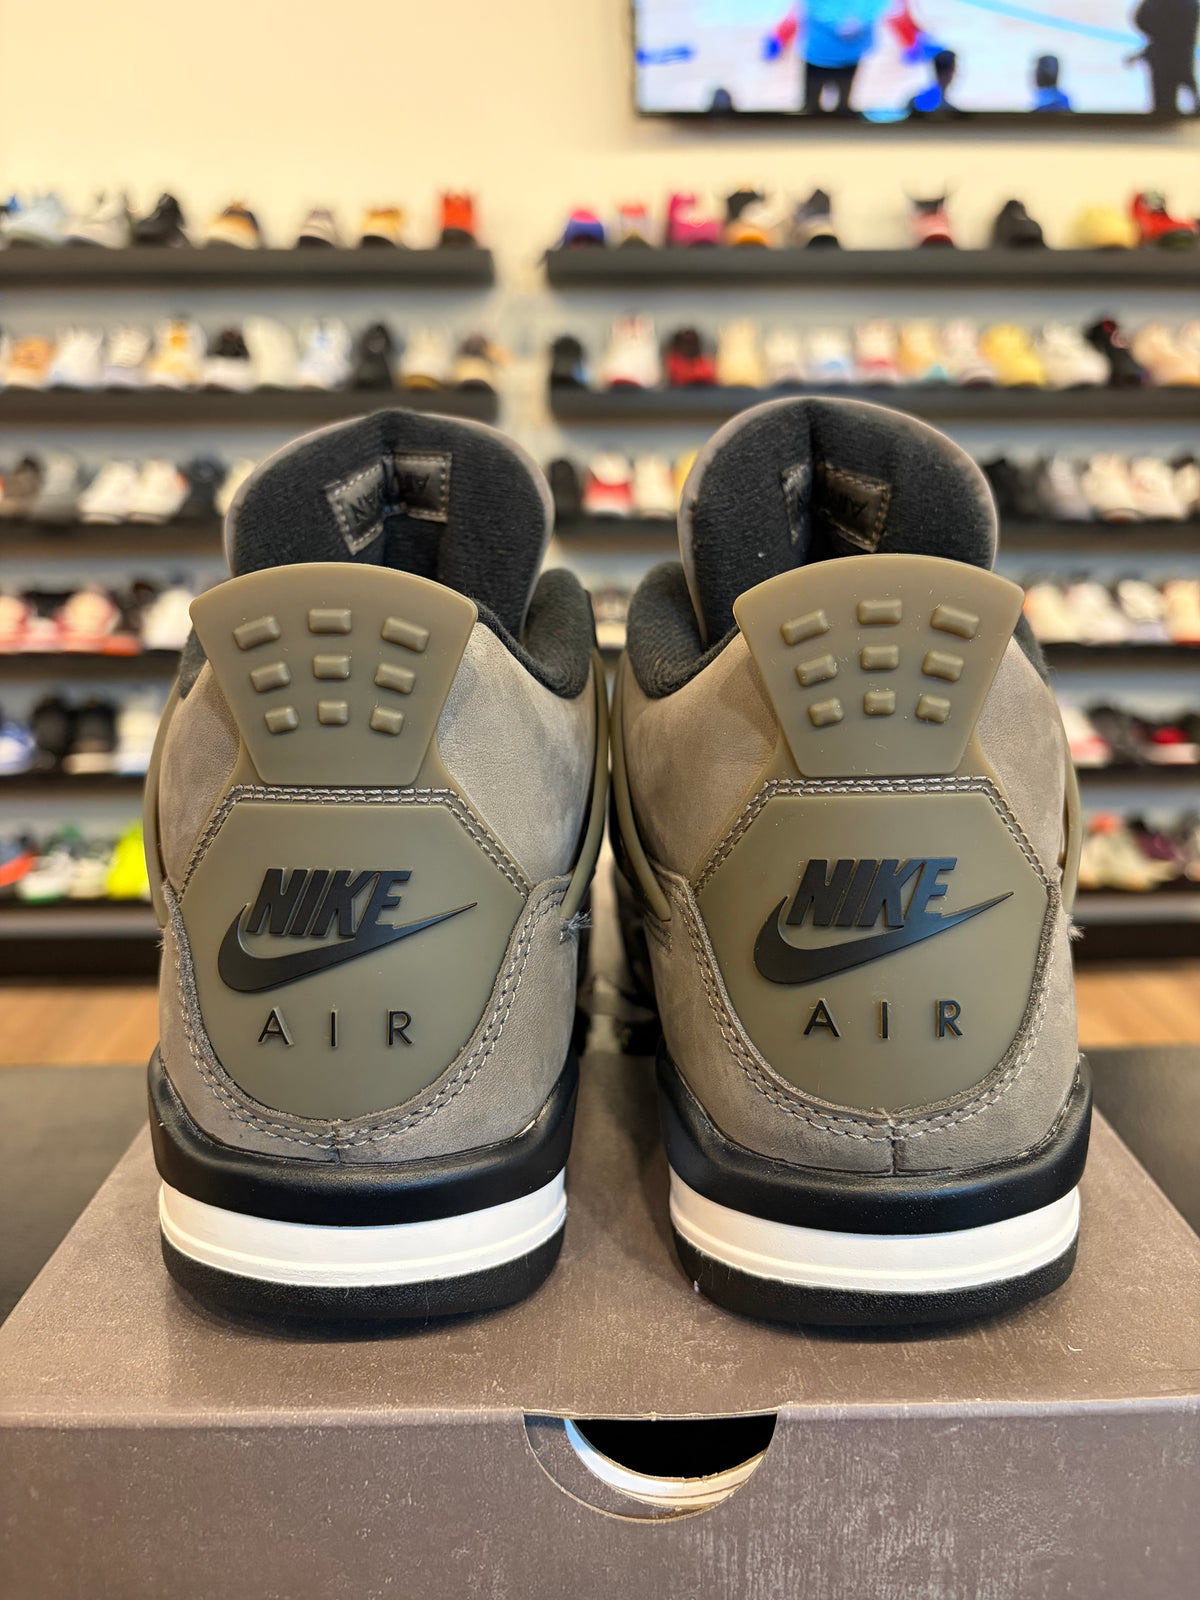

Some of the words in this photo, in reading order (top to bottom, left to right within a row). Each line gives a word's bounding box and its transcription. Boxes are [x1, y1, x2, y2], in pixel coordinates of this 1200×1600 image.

[245, 868, 412, 937] NIKE
[786, 857, 957, 927] NIKE
[258, 1008, 412, 1047] AIR
[803, 999, 963, 1038] AIR
